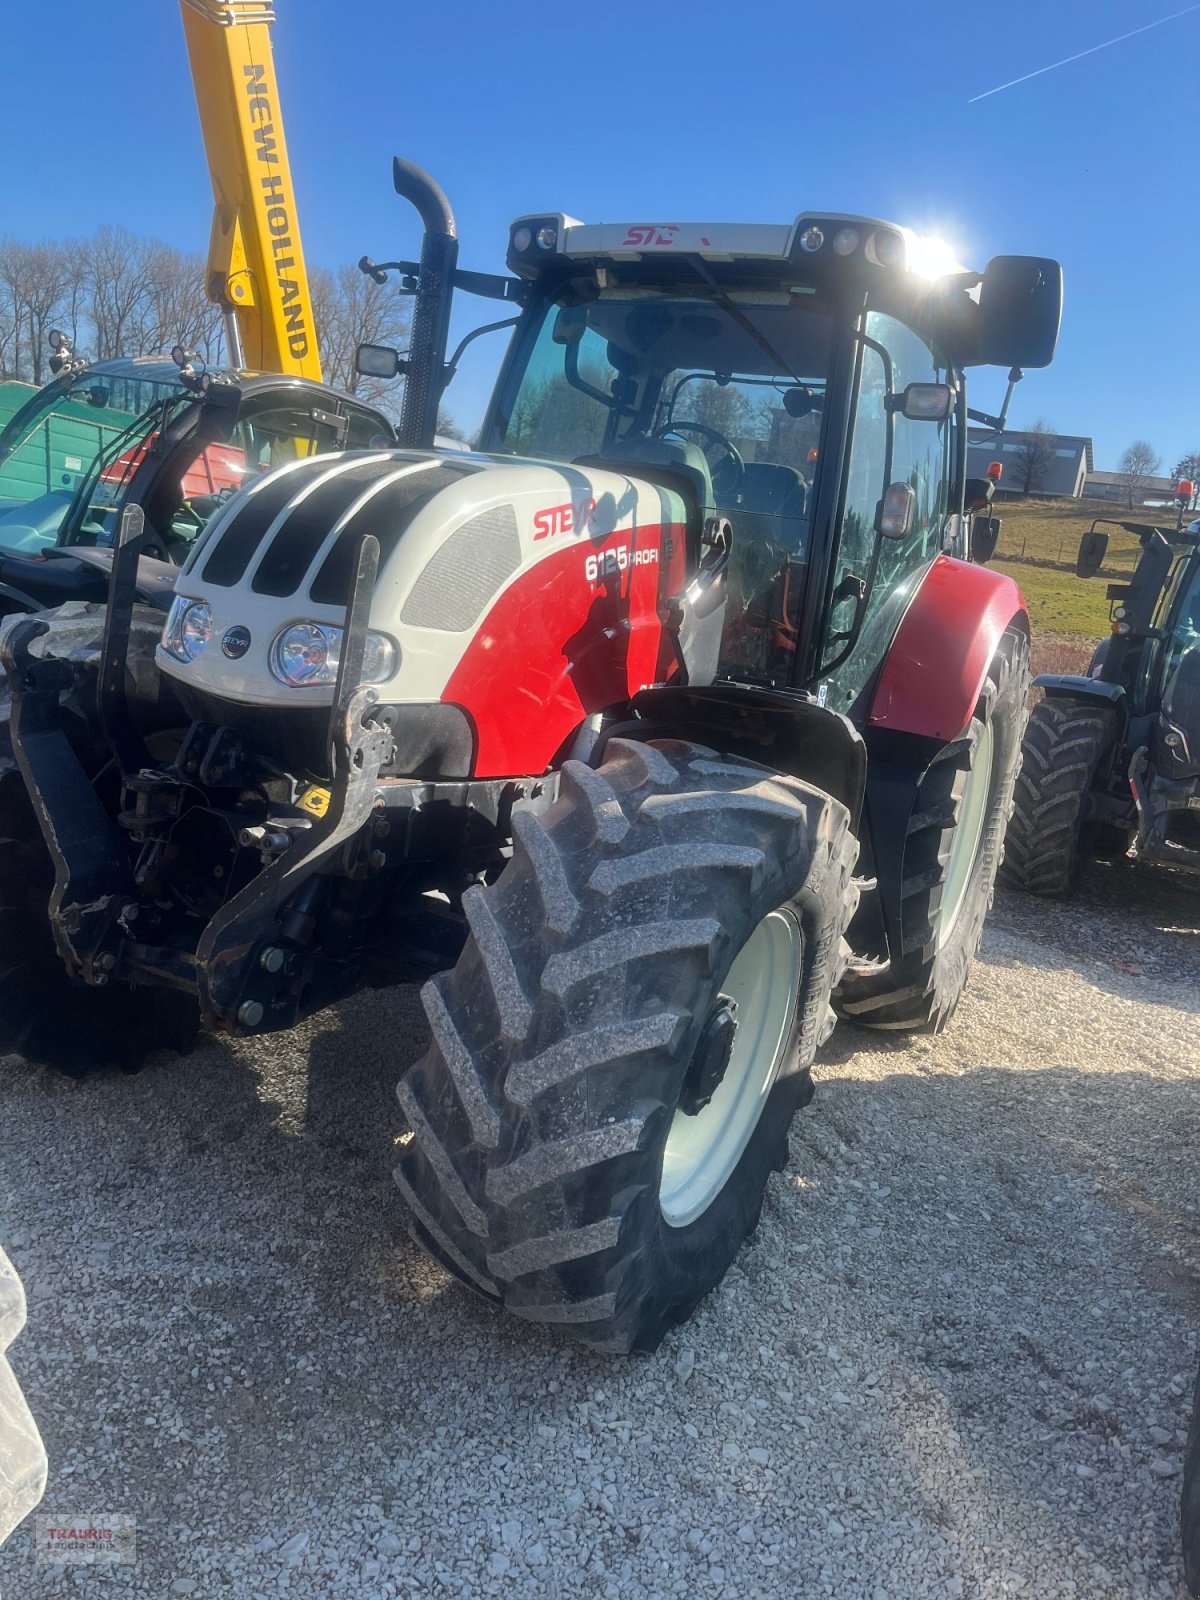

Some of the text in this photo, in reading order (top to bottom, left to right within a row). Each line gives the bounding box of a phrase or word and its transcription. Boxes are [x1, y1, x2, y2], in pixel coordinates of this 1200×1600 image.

[243, 64, 309, 360] NEW HOLLAND
[533, 497, 597, 541] STEYR
[585, 545, 628, 581] 6125
[628, 548, 658, 567] PROFI
[222, 636, 249, 647] STEYR
